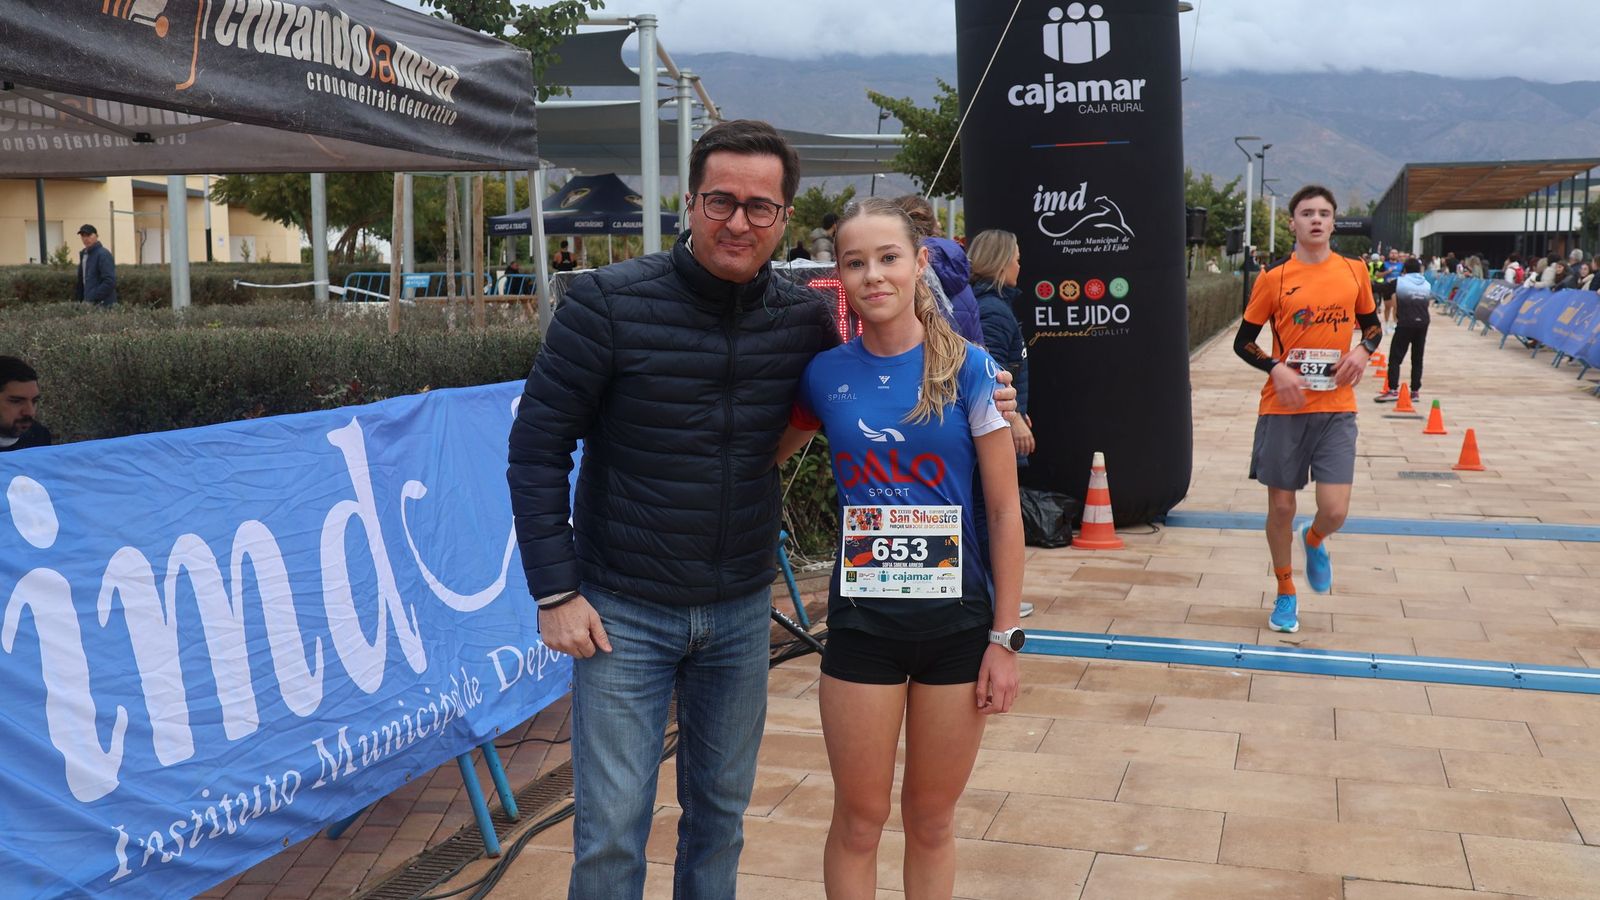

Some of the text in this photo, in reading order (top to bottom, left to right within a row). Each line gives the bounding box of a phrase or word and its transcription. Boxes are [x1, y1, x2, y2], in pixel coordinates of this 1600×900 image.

[306, 71, 459, 126] cronometraje deportivo
[1008, 73, 1146, 113] cajamar
[1078, 102, 1144, 114] CAJA RURAL
[1033, 181, 1088, 213] imd
[1086, 236, 1119, 246] Municipal
[1062, 245, 1092, 255] Deportes
[1103, 244, 1111, 252] El
[1112, 243, 1129, 252] Ejido
[1035, 303, 1130, 326] EL EJIDO
[1090, 328, 1130, 337] QUALITY
[1300, 363, 1328, 374] 637
[827, 392, 857, 401] SPIRAL
[835, 448, 946, 488] GALO
[869, 488, 909, 497] SPORT
[889, 509, 958, 524] San Silvestre
[871, 538, 929, 562] 653
[892, 572, 934, 583] cajamar
[2, 416, 427, 803] imd
[110, 770, 301, 882] Instituto
[312, 667, 467, 789] Municipal
[462, 676, 483, 709] de
